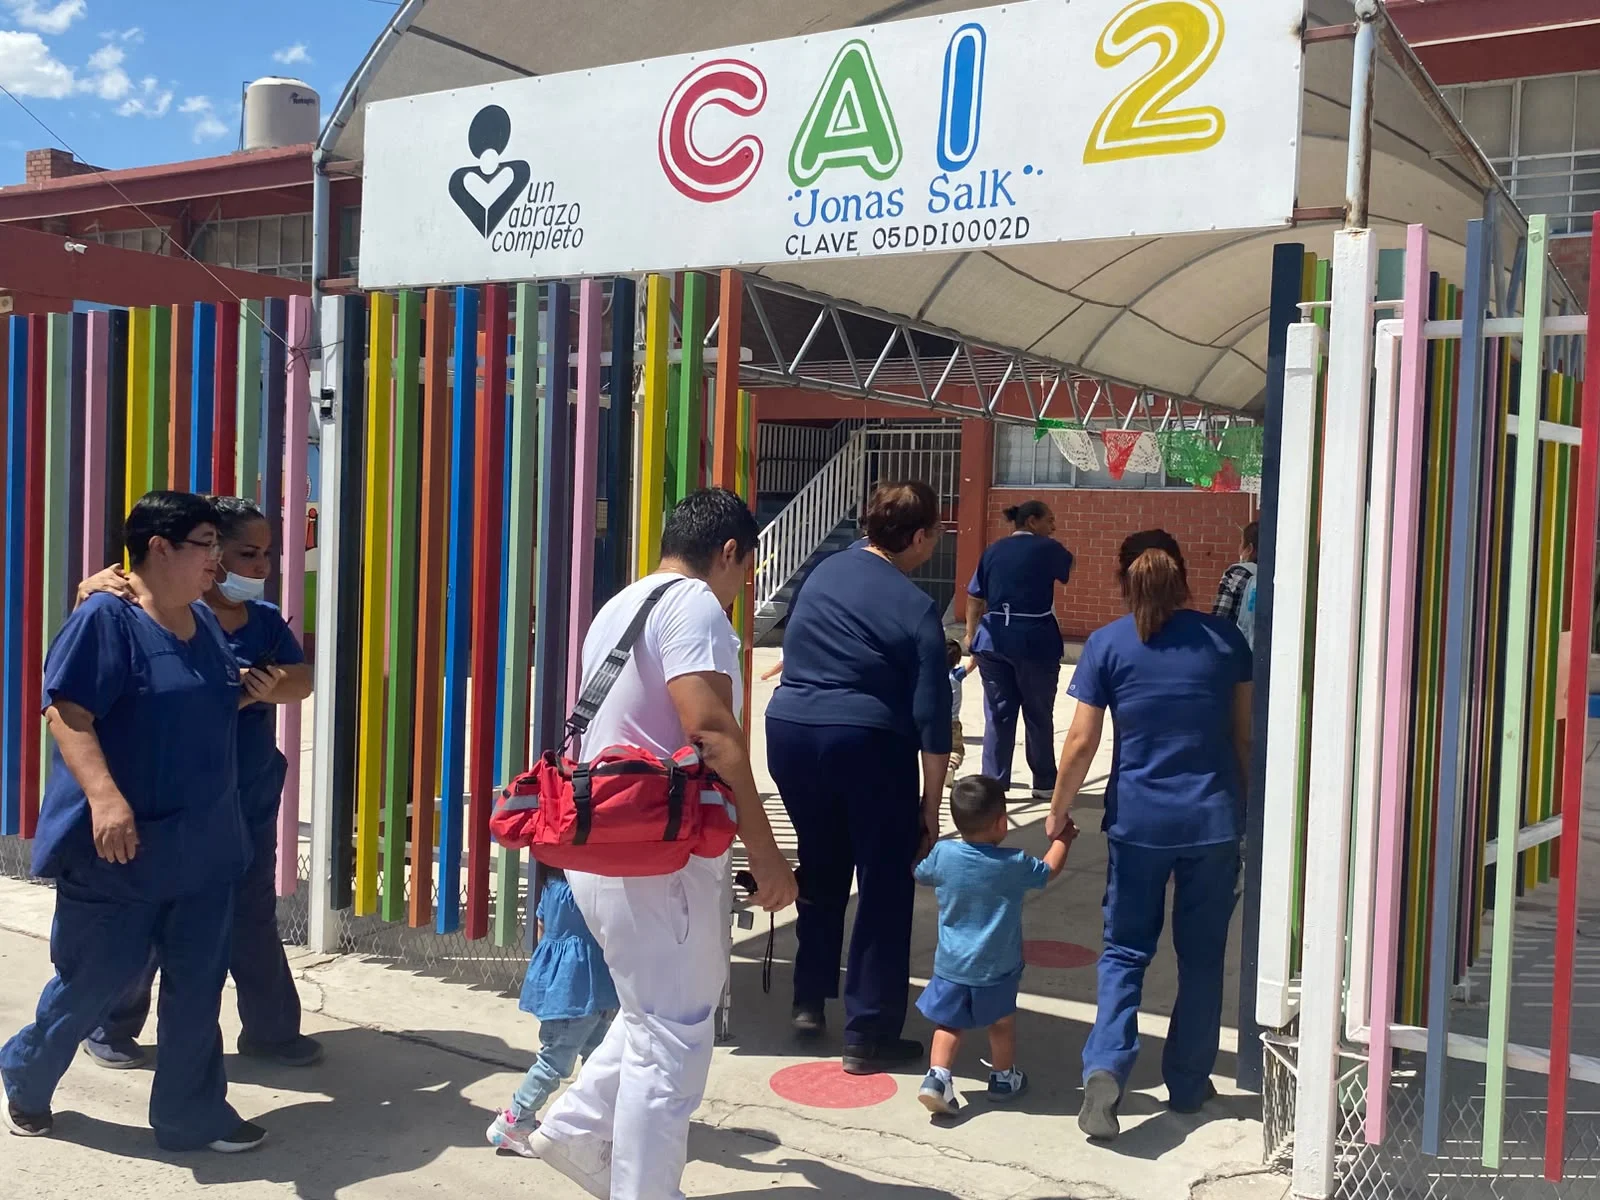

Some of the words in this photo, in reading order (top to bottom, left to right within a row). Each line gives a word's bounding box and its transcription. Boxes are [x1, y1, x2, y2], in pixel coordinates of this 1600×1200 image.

[1082, 0, 1226, 164] 2
[527, 180, 556, 204] un
[507, 202, 582, 229] abrazo
[492, 225, 584, 258] completo
[784, 230, 859, 257] CLAVE
